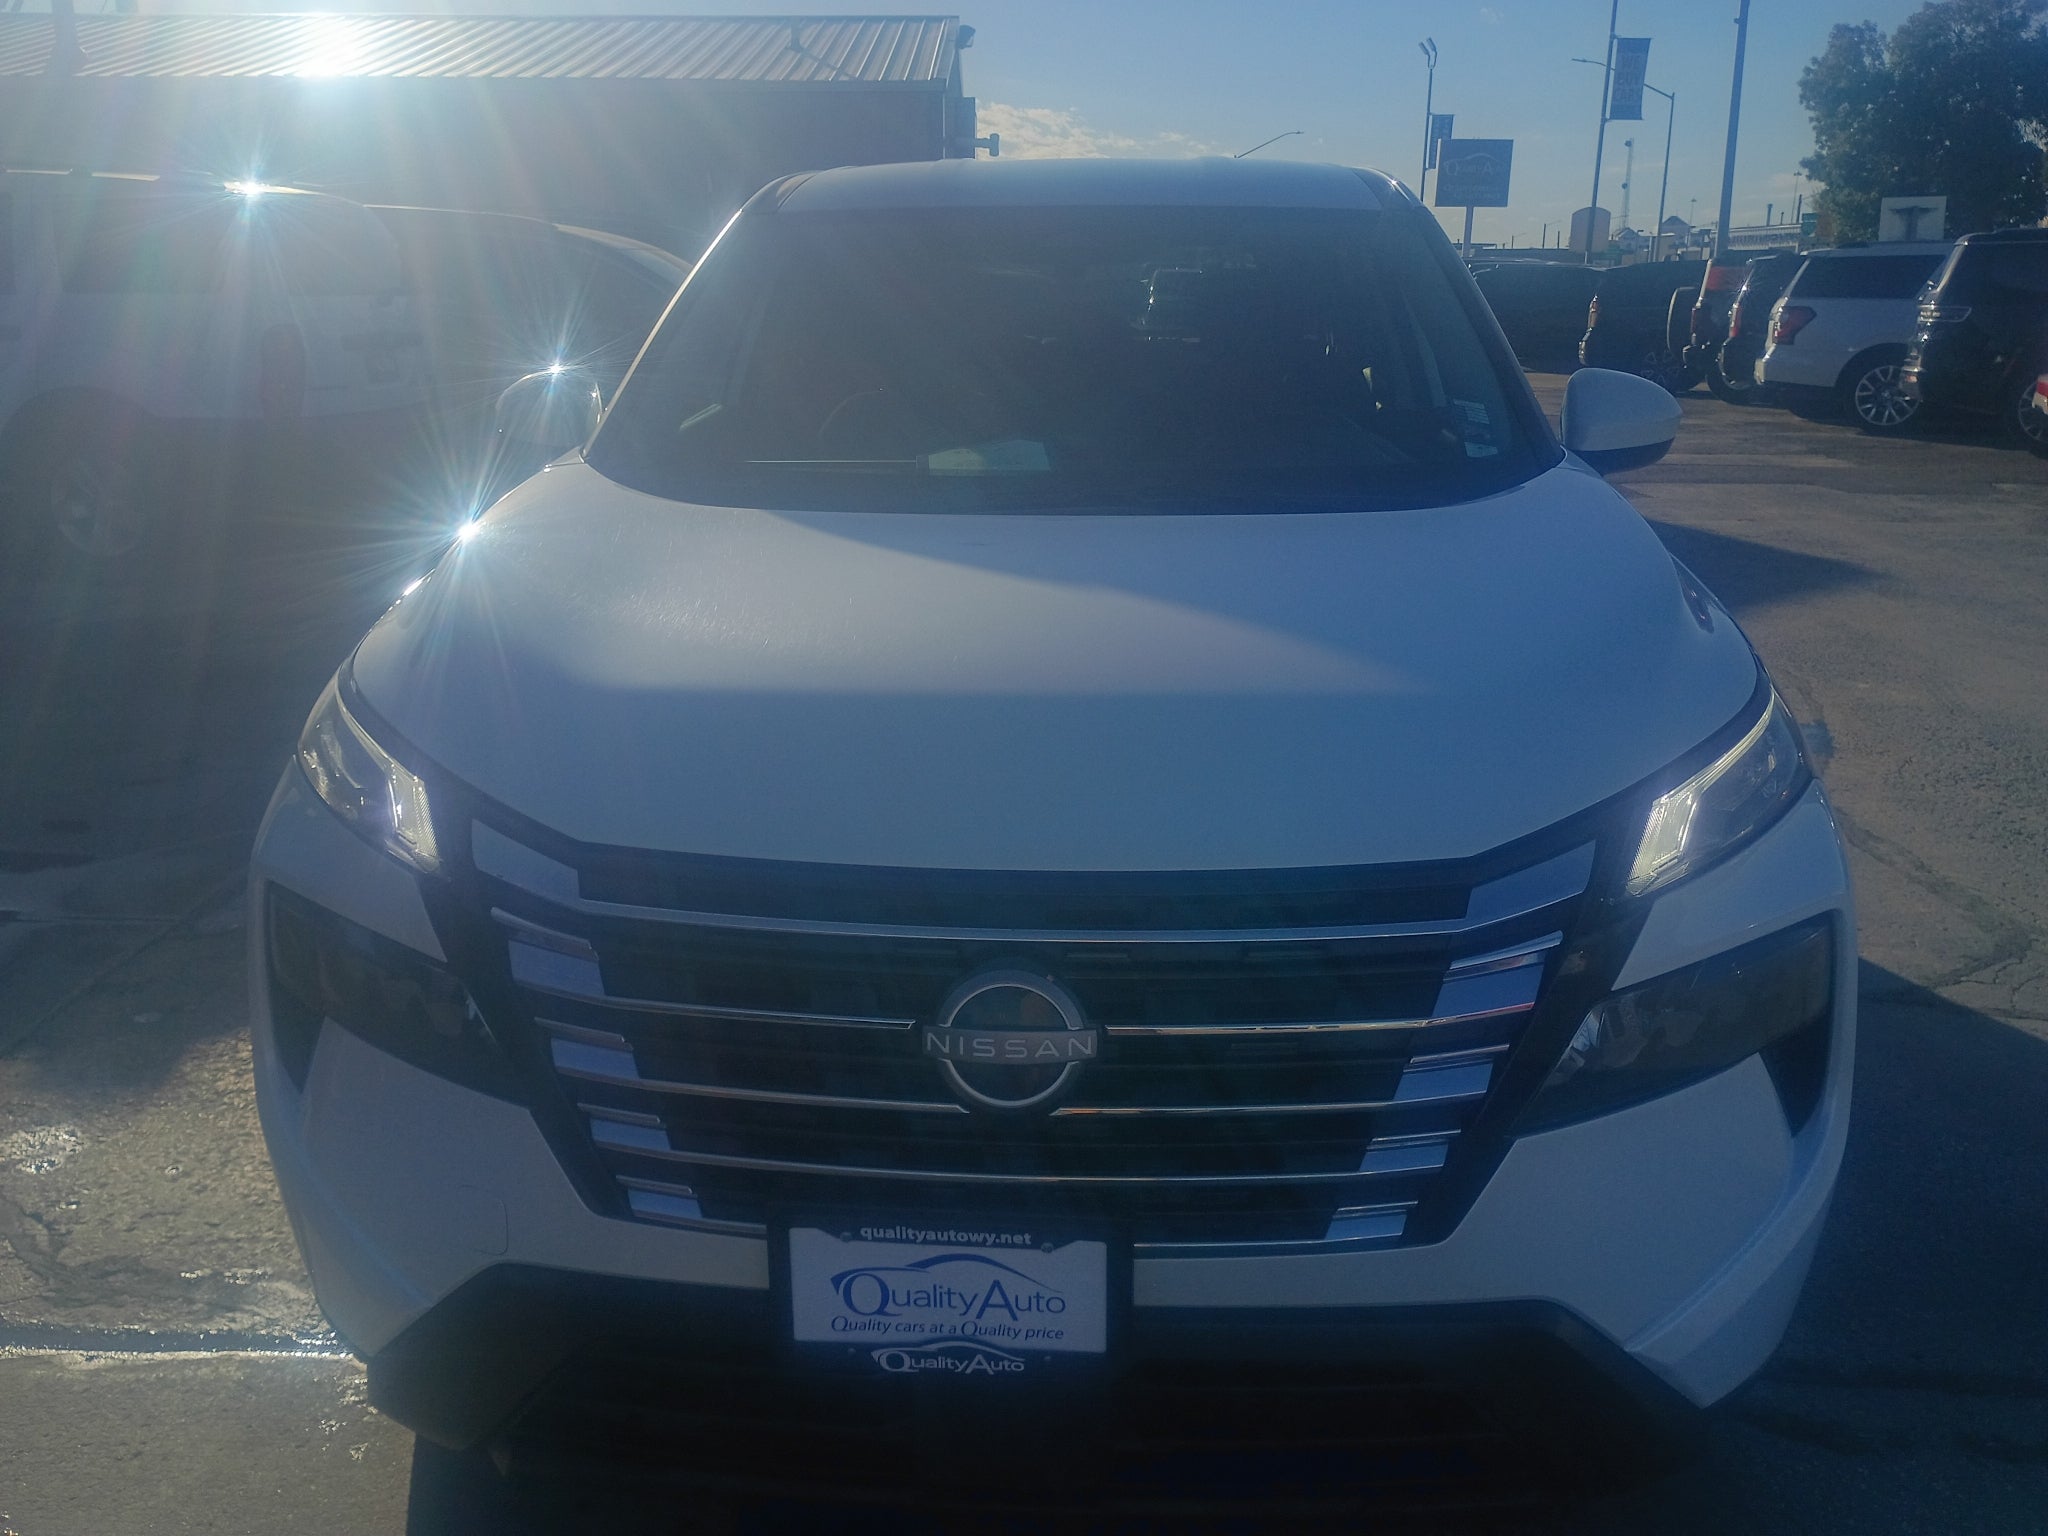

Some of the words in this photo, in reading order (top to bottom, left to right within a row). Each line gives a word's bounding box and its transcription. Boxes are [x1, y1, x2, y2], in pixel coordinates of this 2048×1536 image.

[926, 1032, 1093, 1059] NISSAN
[860, 1225, 1032, 1246] qualityautowy.net
[831, 1315, 891, 1335] Quality
[894, 1319, 926, 1333] cars
[929, 1321, 946, 1335] at
[948, 1325, 958, 1336] a
[960, 1319, 1022, 1339] Quality
[1024, 1325, 1065, 1341] price
